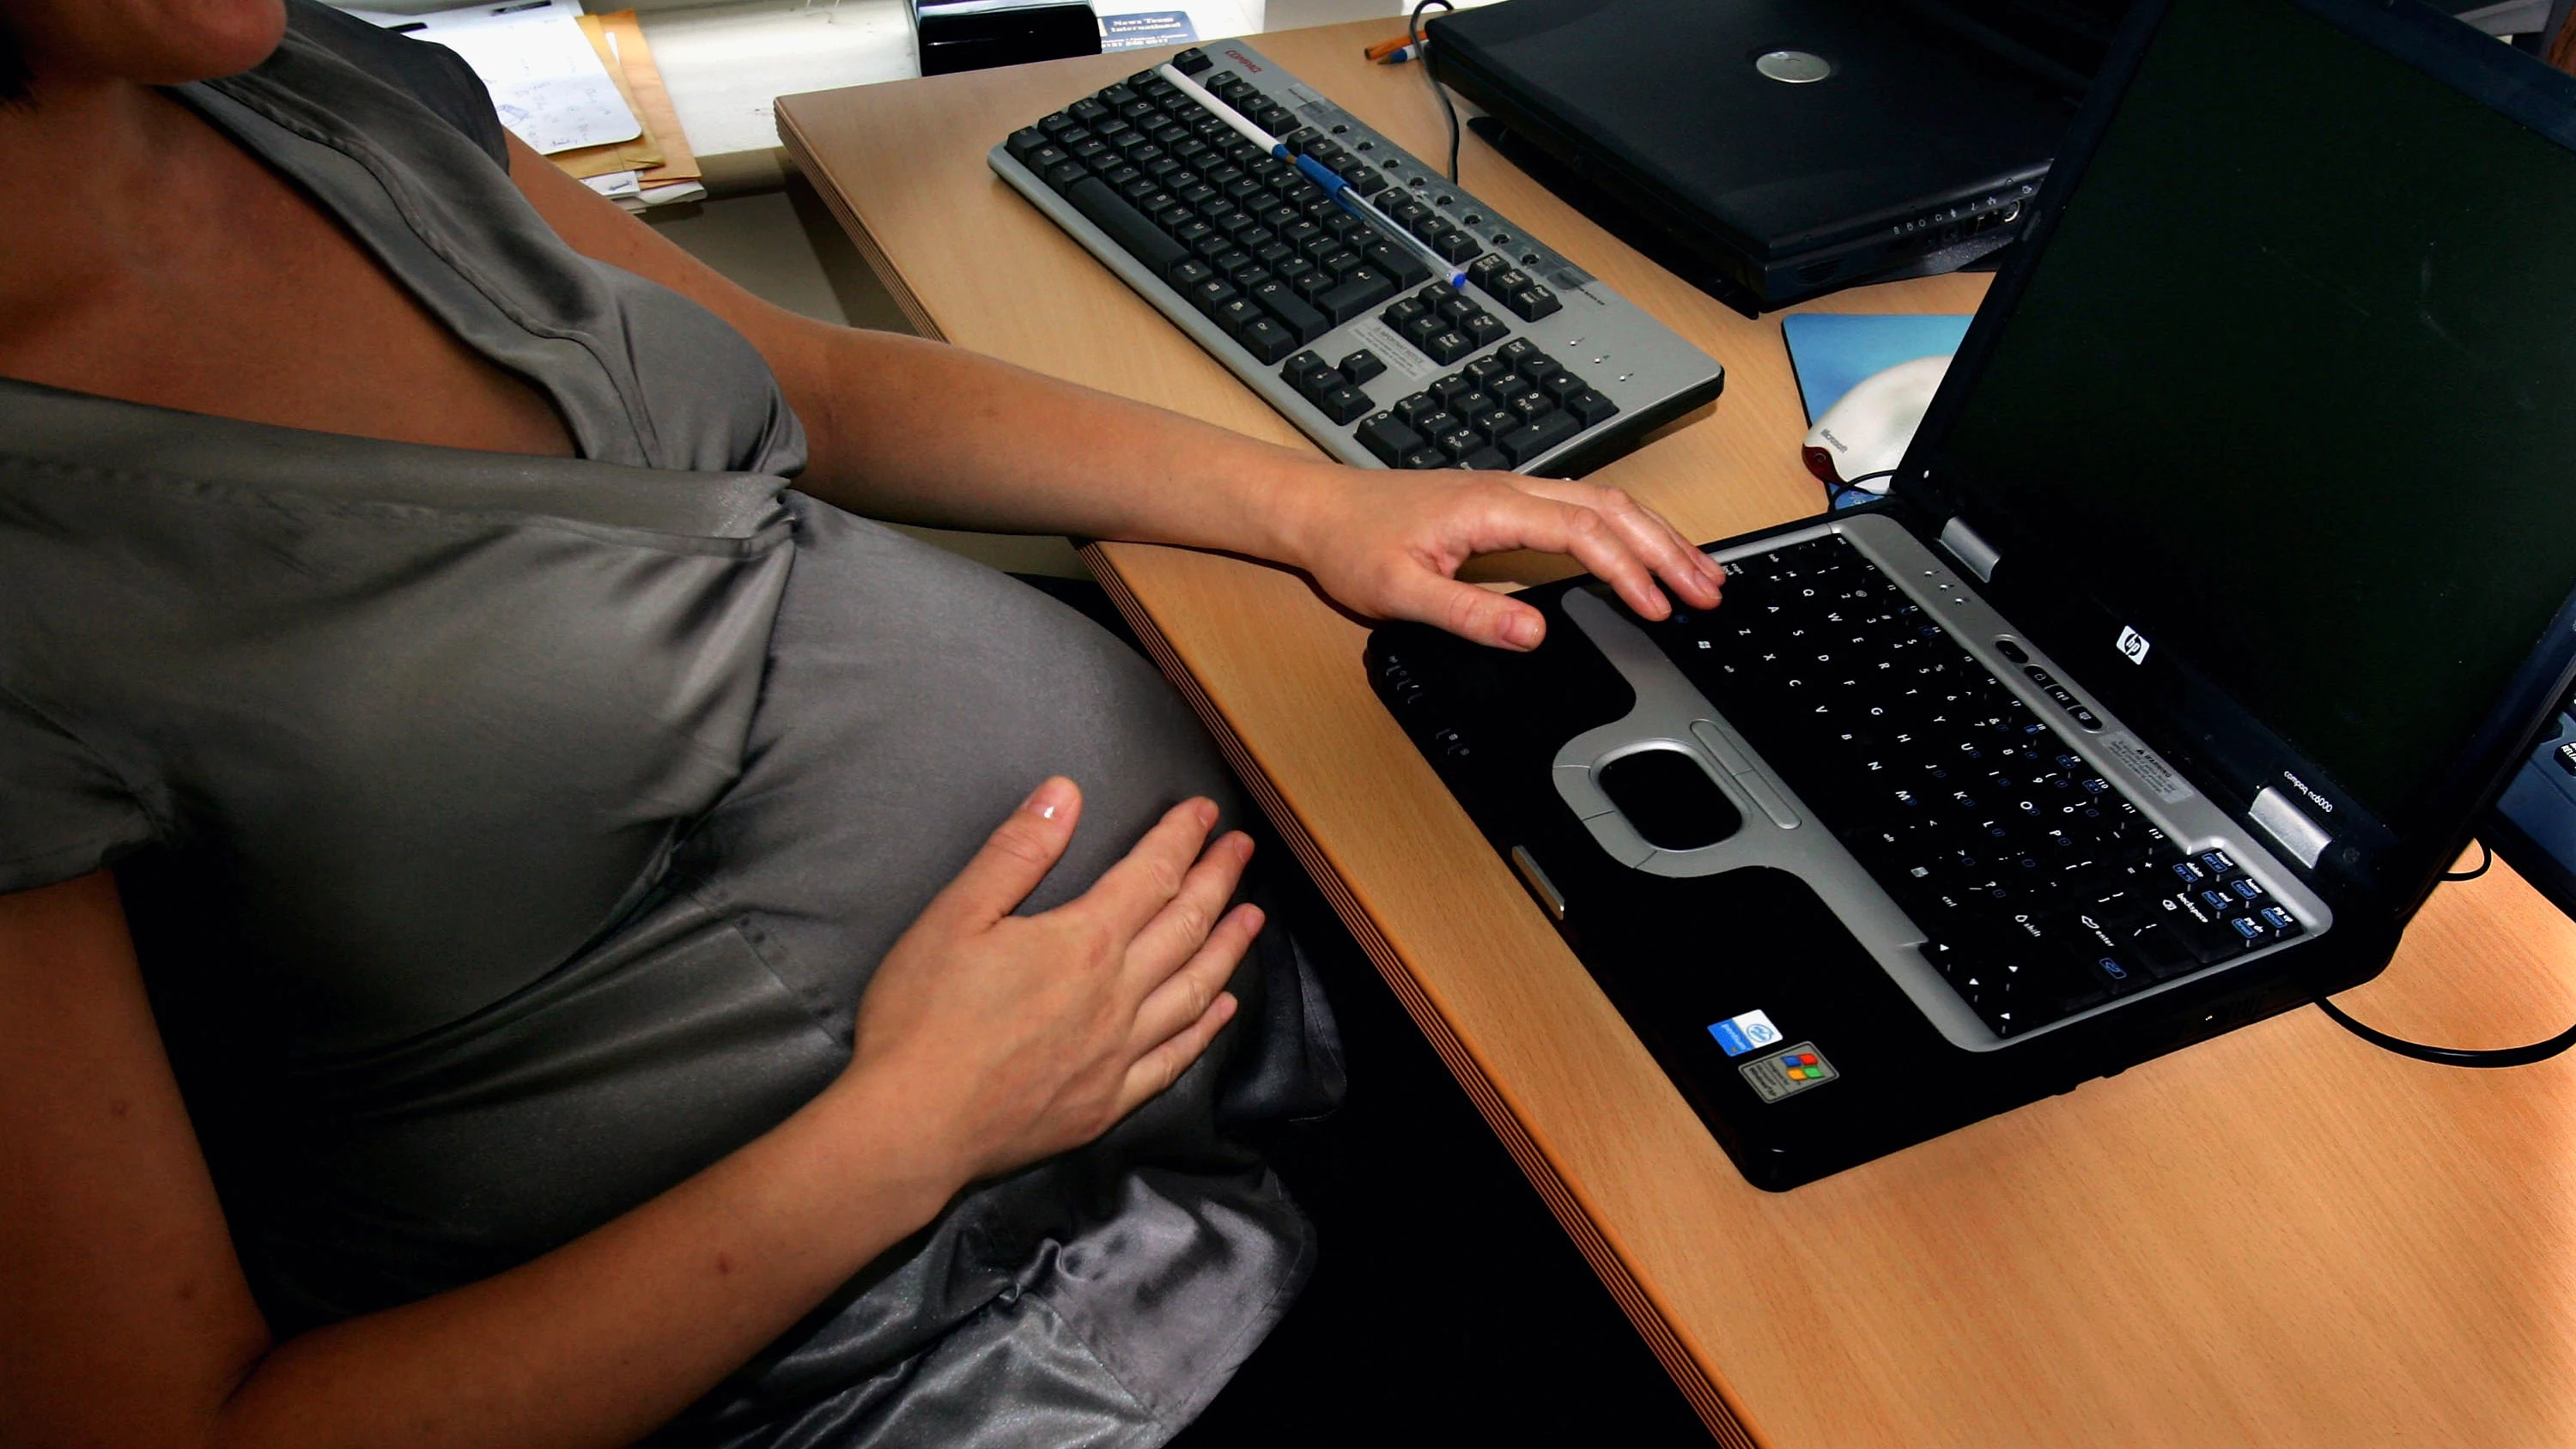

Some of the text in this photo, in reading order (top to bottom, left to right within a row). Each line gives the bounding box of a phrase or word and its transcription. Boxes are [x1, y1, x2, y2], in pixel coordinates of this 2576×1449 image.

[1111, 22, 1181, 33] International
[1820, 429, 1848, 453] Microsoft
[2125, 634, 2141, 656] hp
[1896, 791, 1911, 800] M
[2284, 771, 2333, 813] compaq nc6000
[2216, 852, 2233, 866] insert
[2186, 862, 2204, 877] delete
[2245, 878, 2263, 894] home
[2219, 893, 2233, 902] end
[2177, 893, 2208, 923] backspace
[2274, 906, 2285, 917] pg
[2244, 917, 2255, 928] pg
[2024, 924, 2040, 937] shift
[2096, 931, 2114, 946] enter
